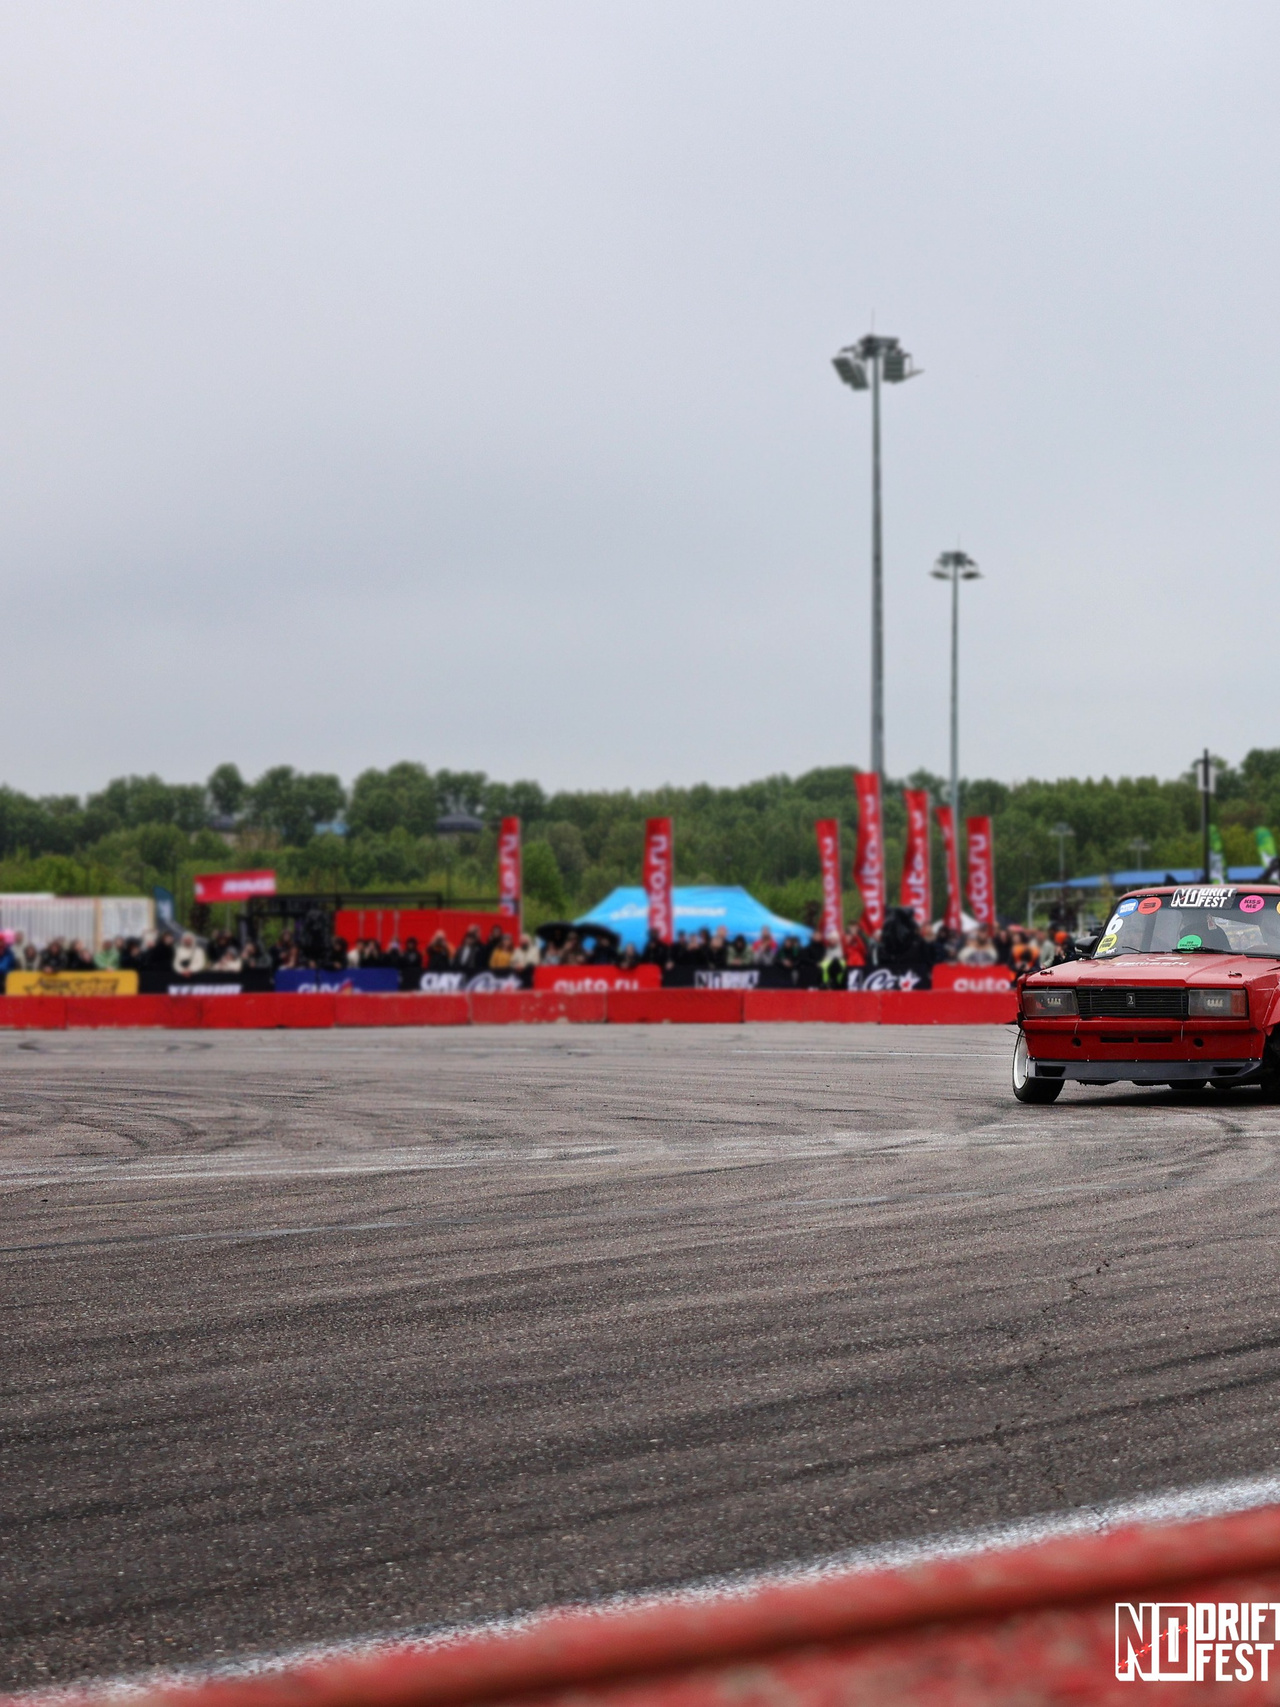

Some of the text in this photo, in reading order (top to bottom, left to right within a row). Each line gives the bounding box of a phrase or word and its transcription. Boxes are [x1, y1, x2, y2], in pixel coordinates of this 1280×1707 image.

[1200, 888, 1237, 898] DRIFT
[1199, 897, 1228, 908] FEST
[1105, 913, 1124, 936] 6
[554, 978, 639, 992] auto.ru
